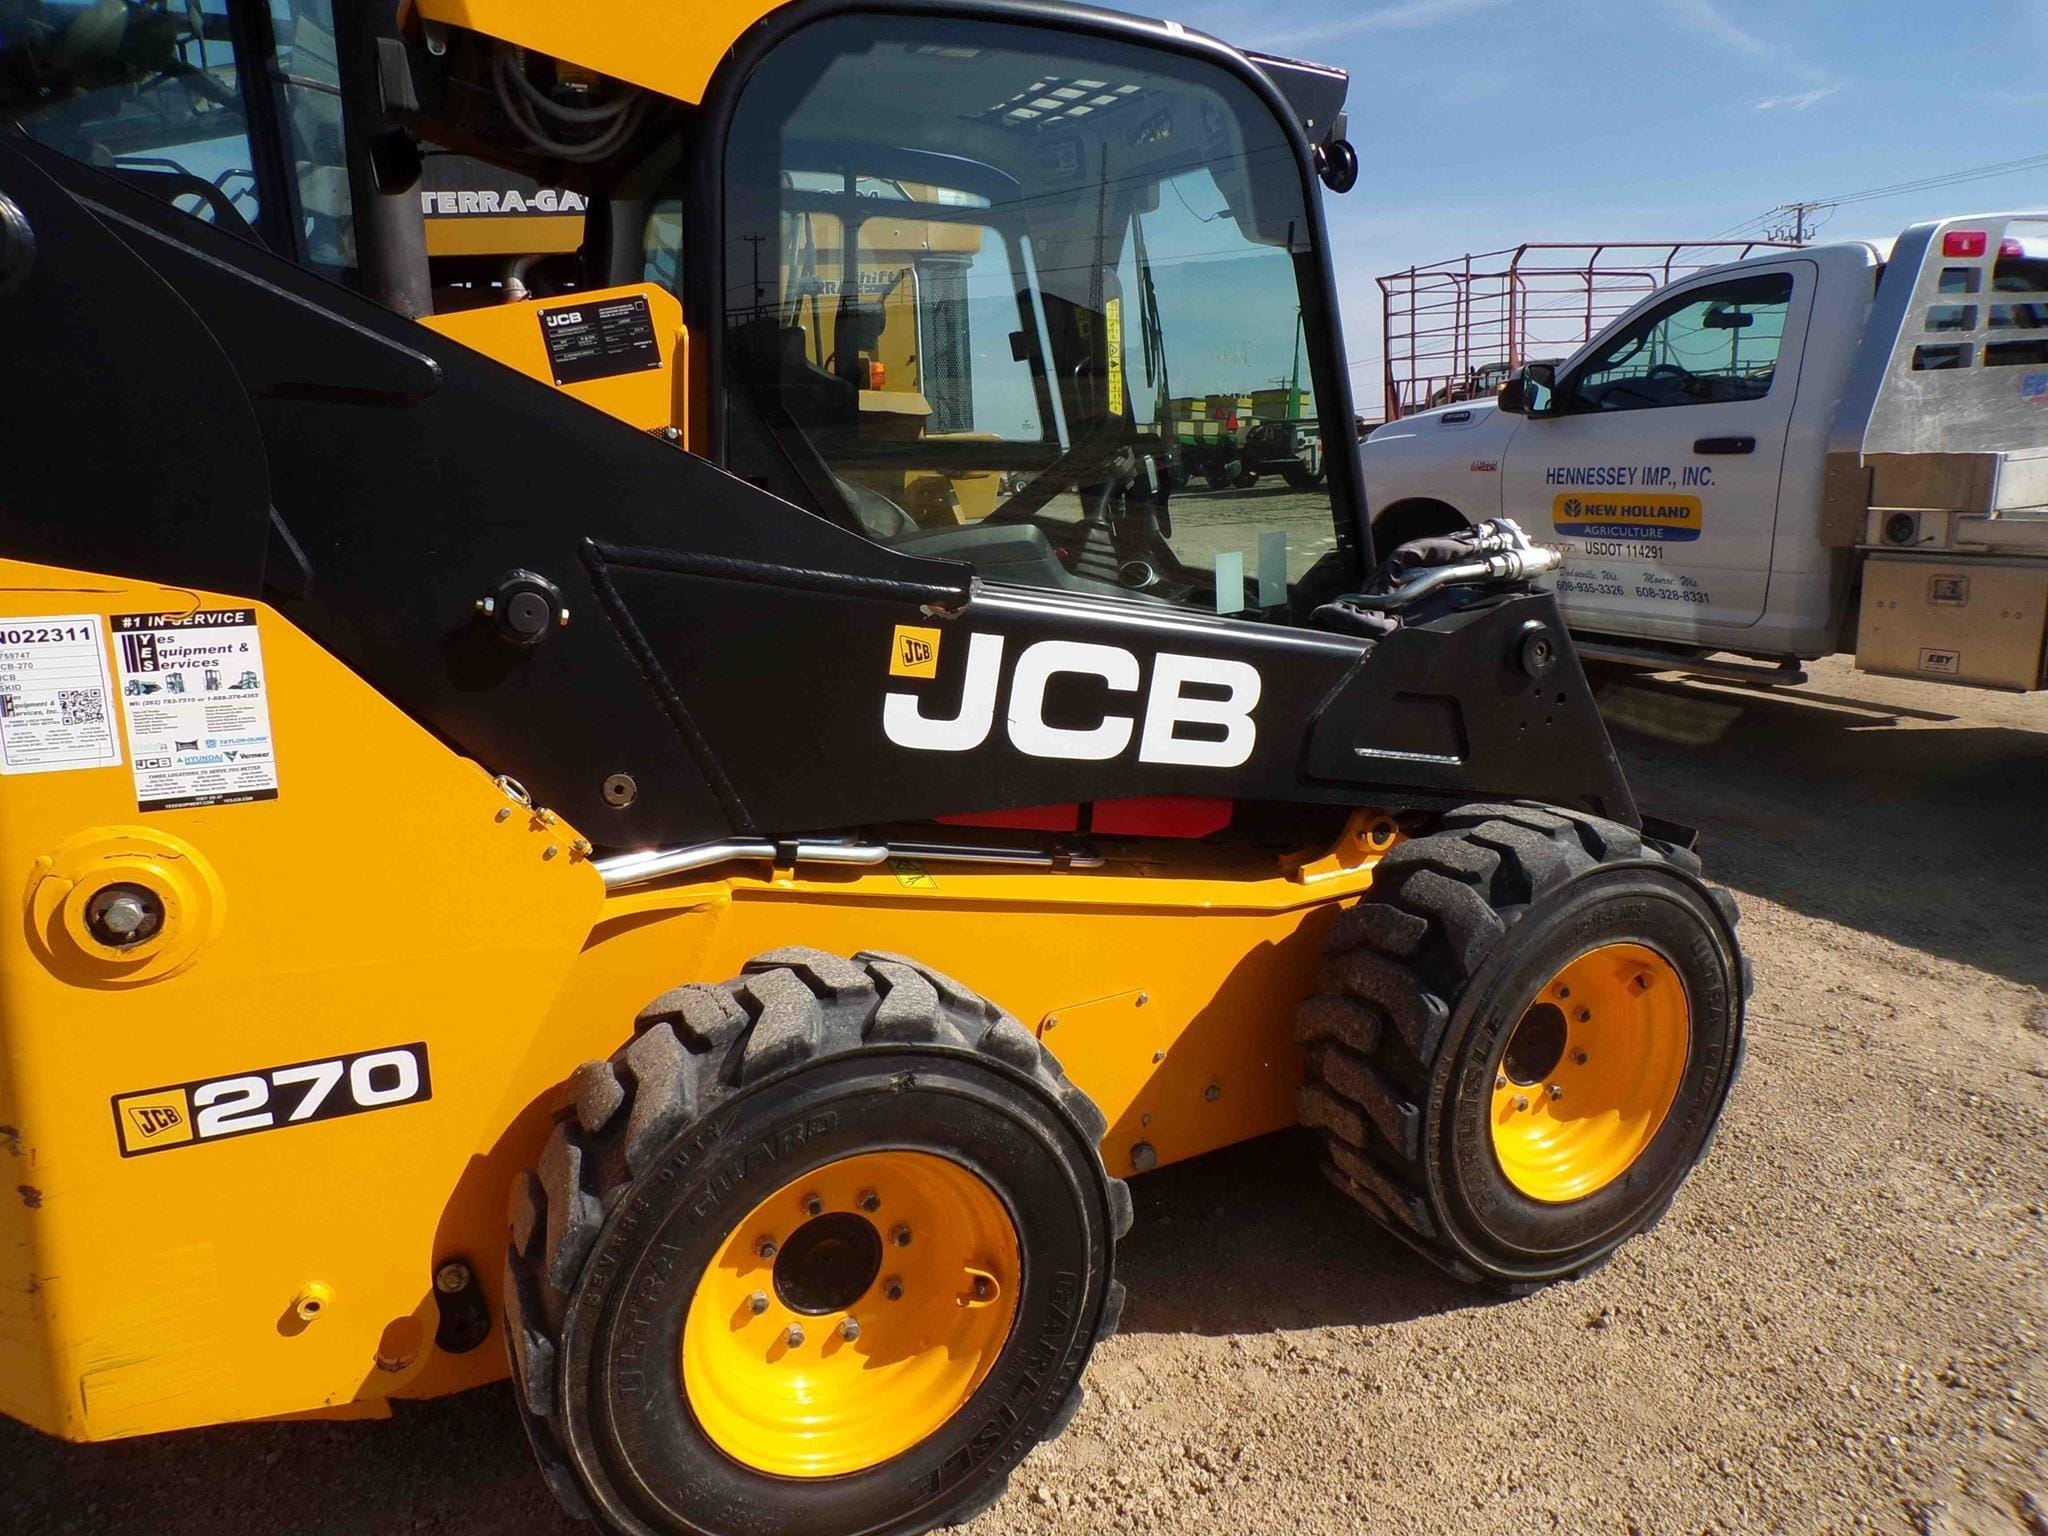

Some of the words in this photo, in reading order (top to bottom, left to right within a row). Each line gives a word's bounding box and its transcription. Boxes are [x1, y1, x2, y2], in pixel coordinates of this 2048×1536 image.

[547, 312, 582, 327] JCB
[1546, 467, 1637, 485] HENNESSEY
[1682, 467, 1715, 486] INC.
[1585, 505, 1617, 517] NEW
[1621, 505, 1690, 519] HOLLAND
[1584, 526, 1663, 538] AGRICULTURE
[1585, 542, 1622, 557] USDOT
[1626, 545, 1663, 560] 114291
[1556, 580, 1624, 596] 608-935-3326
[1636, 586, 1711, 604] 608-328-8331
[122, 617, 141, 628] #1
[239, 643, 249, 652] &
[904, 639, 931, 662] JCB
[883, 632, 1262, 768] JCB
[136, 758, 171, 769] JCB
[185, 754, 223, 763] HYUNDAI
[240, 752, 269, 760] Vermeer
[194, 1050, 419, 1138] 270
[138, 1107, 179, 1134] JCB
